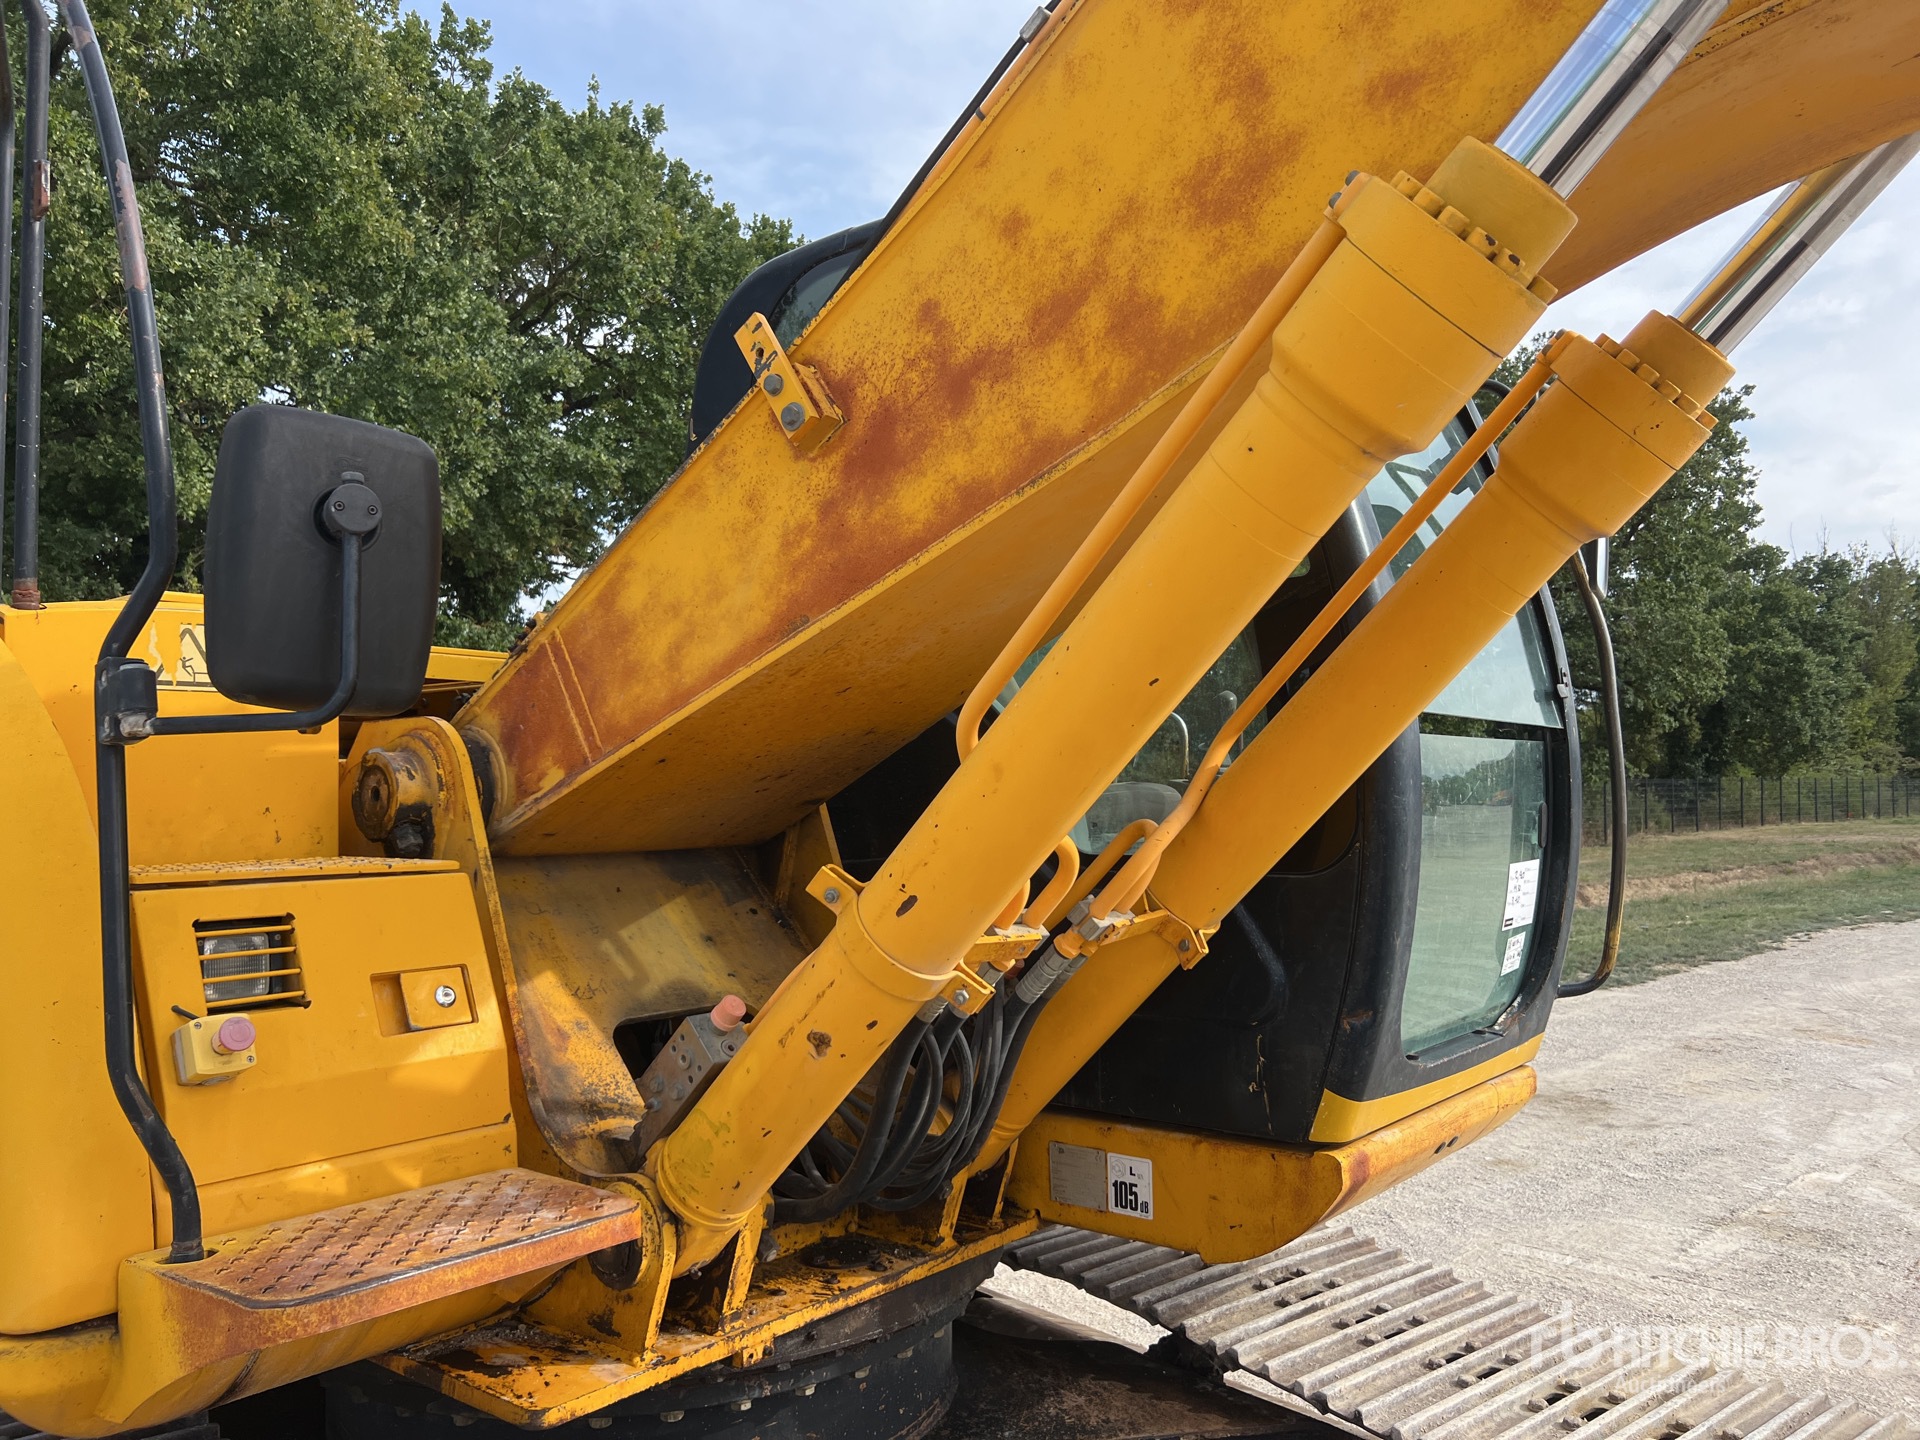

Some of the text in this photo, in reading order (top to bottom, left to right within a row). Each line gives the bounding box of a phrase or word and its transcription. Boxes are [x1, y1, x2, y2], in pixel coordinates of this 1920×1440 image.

[1129, 1166, 1136, 1176] L
[1112, 1180, 1138, 1211] 105
[1140, 1201, 1149, 1214] dB
